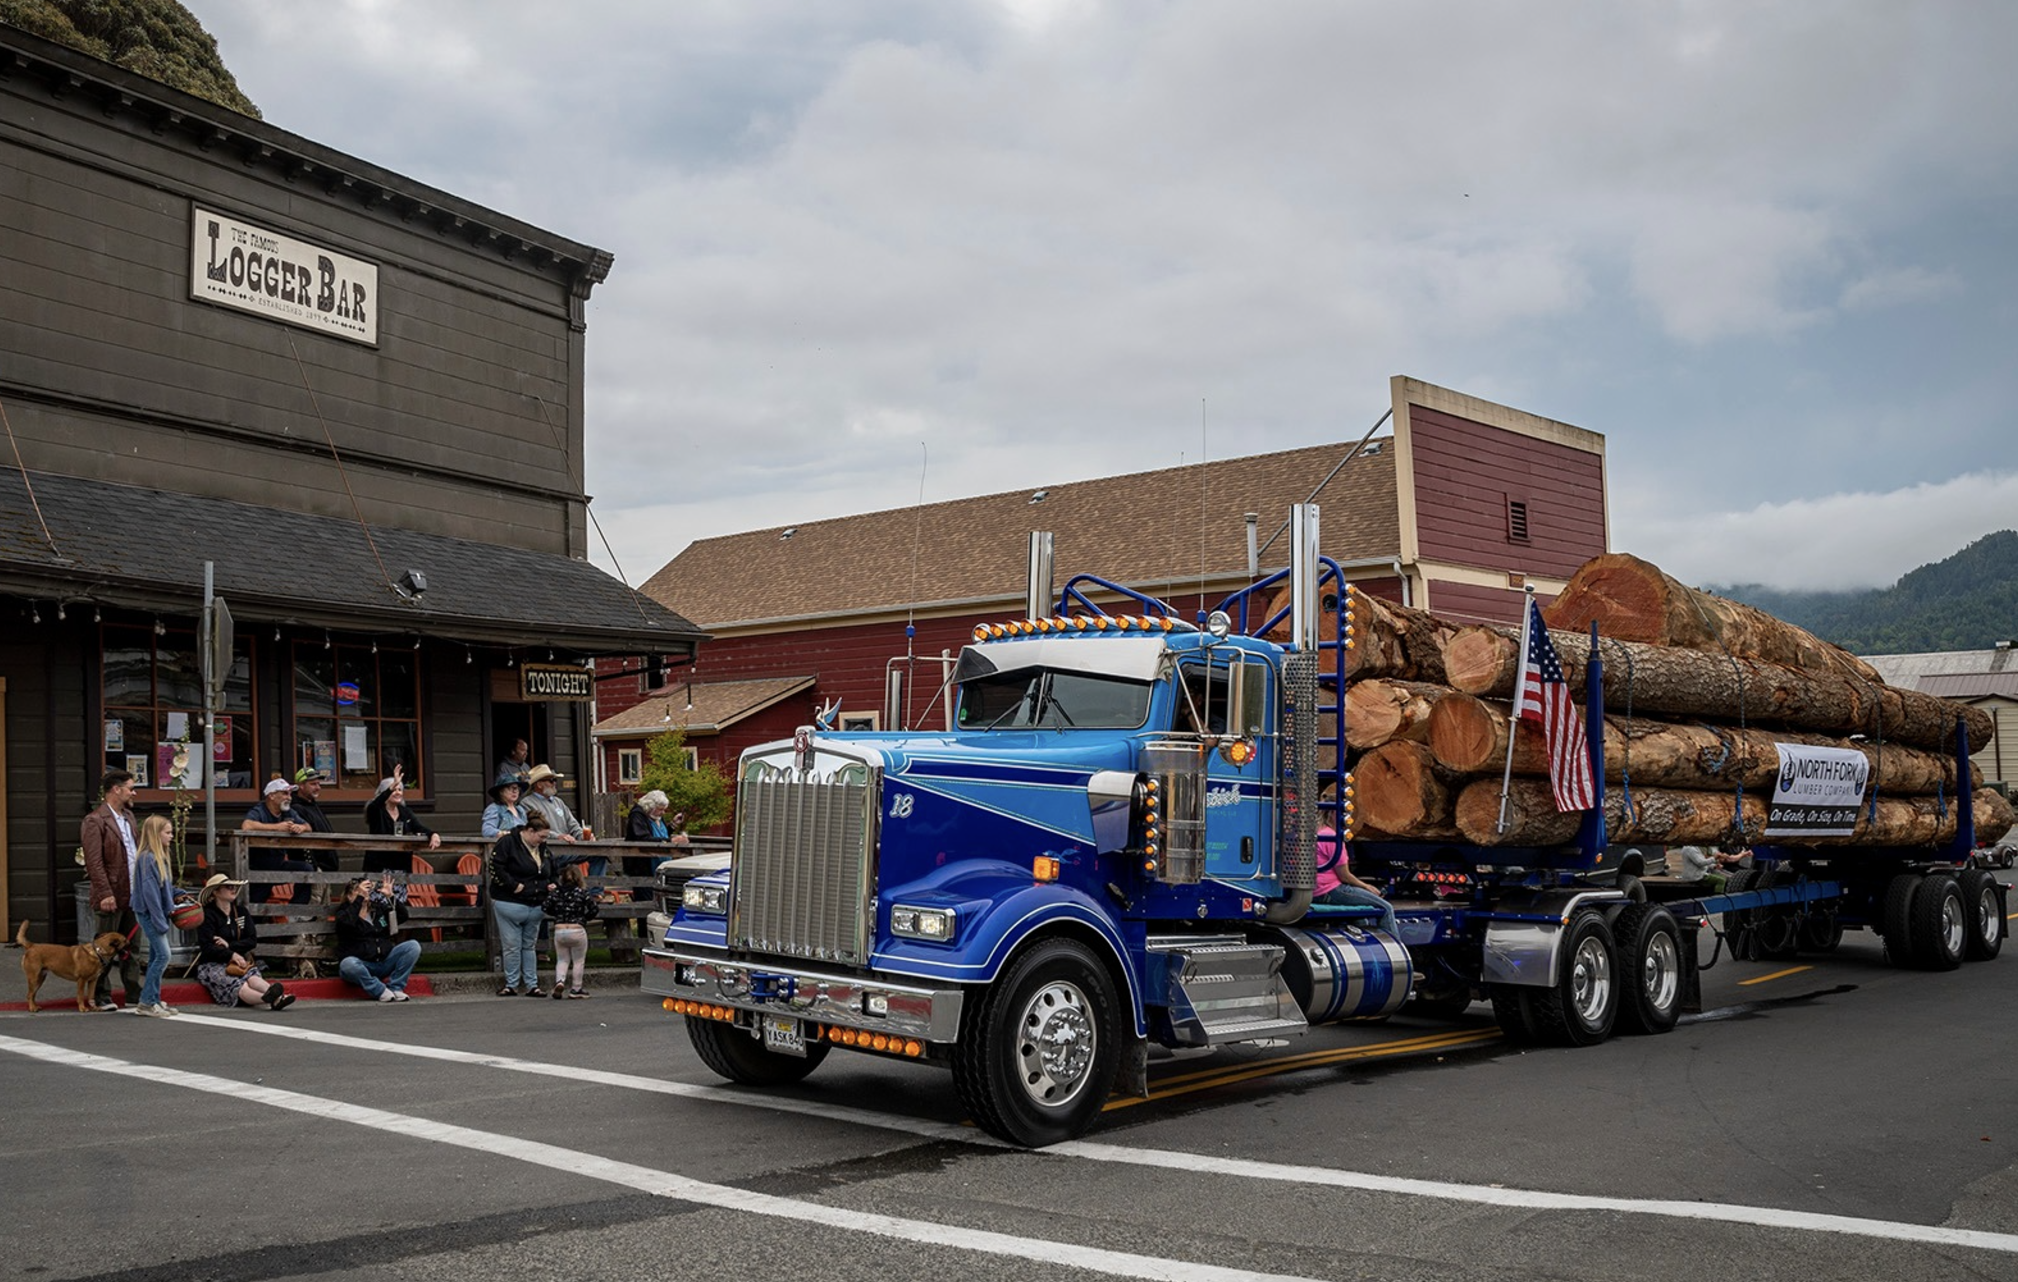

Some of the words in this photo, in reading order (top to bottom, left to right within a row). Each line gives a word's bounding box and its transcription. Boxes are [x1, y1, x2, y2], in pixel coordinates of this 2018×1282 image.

[231, 227, 247, 245] THE
[251, 233, 279, 254] FAMOUS
[207, 220, 312, 308] LOGGER
[317, 255, 366, 323] BAR
[258, 297, 302, 316] ESTABLISHED
[528, 672, 589, 694] TONIGHT
[1797, 759, 1833, 780] NORTH
[1833, 761, 1858, 781] FORK
[1793, 784, 1822, 795] LUMBER
[1825, 785, 1853, 796] COMPANY
[889, 793, 915, 818] 18
[1770, 809, 1782, 821] On
[1807, 810, 1818, 822] On
[1833, 810, 1843, 822] On
